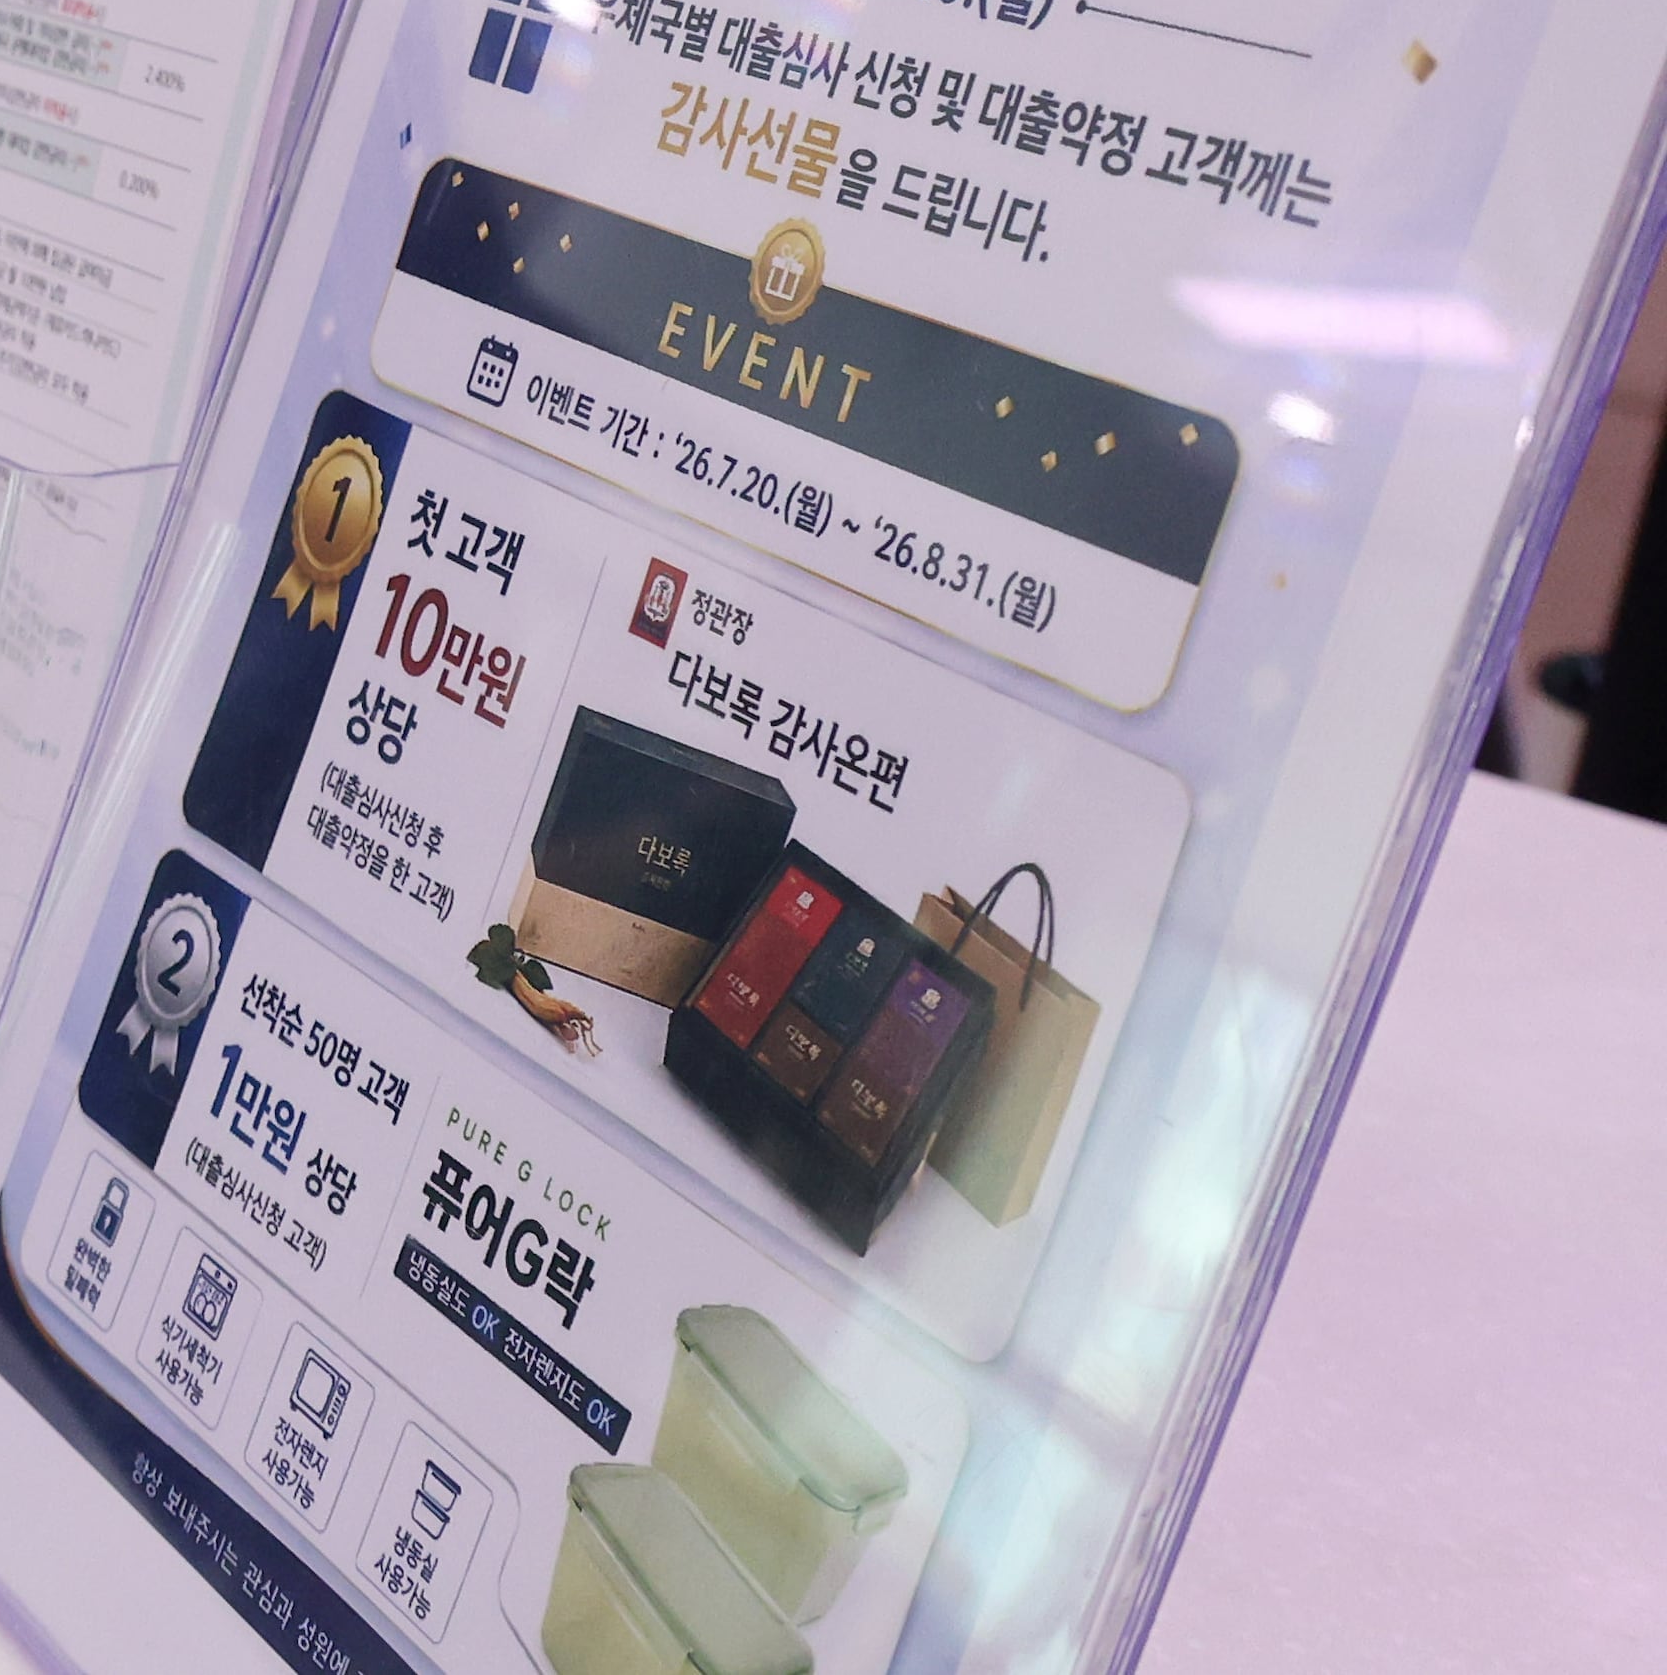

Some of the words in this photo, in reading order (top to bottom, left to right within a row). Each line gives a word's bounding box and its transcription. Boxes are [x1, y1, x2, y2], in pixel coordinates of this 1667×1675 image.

[656, 79, 879, 211] 감사선물을
[880, 164, 1052, 263] 드립니다.
[717, 16, 850, 100] 대출심사
[855, 49, 930, 121] 신청
[930, 70, 976, 134] 및
[978, 82, 1149, 180] 대출약정
[1144, 124, 1335, 230] 고객께는
[524, 370, 596, 434] 이벤트
[597, 400, 650, 461] 기간
[655, 300, 873, 425] EVENT
[324, 476, 351, 543] 1
[406, 488, 449, 559] 첫
[444, 510, 525, 597] 고객
[374, 572, 528, 730] 10만원
[689, 586, 757, 647] 정관장
[345, 679, 419, 766] 상당
[667, 647, 764, 740] 다보록
[766, 697, 909, 815] 감사온편
[306, 803, 391, 877] 대출약정을
[390, 857, 416, 894] 한
[414, 868, 458, 923] 고객)
[320, 760, 427, 849] (대출심사신청
[422, 819, 448, 858] 후
[636, 834, 693, 878] 다보록
[156, 928, 197, 996] 2
[241, 971, 305, 1049] 선착순
[303, 1022, 365, 1089] 50명
[363, 1062, 412, 1127] 고객
[207, 1043, 307, 1176] 1만원
[304, 1146, 359, 1216] 상당
[446, 1105, 508, 1166] PURE
[517, 1159, 534, 1183] G
[542, 1176, 613, 1242] LOCK
[184, 1135, 288, 1244] (대출심사신청
[284, 1215, 329, 1273] 고객)
[421, 1148, 597, 1331] 퓨어G락
[155, 1347, 204, 1407] 사용가능
[161, 1314, 224, 1386] 식기세척기
[407, 1249, 471, 1320] 냉동실도
[471, 1302, 502, 1343] OK
[502, 1326, 586, 1413] 전자렌지도
[585, 1396, 618, 1438] OK
[261, 1447, 316, 1510] 사용가능
[273, 1415, 330, 1482] 전자렌지
[132, 1451, 164, 1498] 항상
[162, 1484, 239, 1577] 보내주시는
[241, 1560, 295, 1632] 관심과
[296, 1616, 351, 1675] 성원에
[373, 1552, 432, 1621] 사용가능
[393, 1525, 440, 1585] 냉동실
